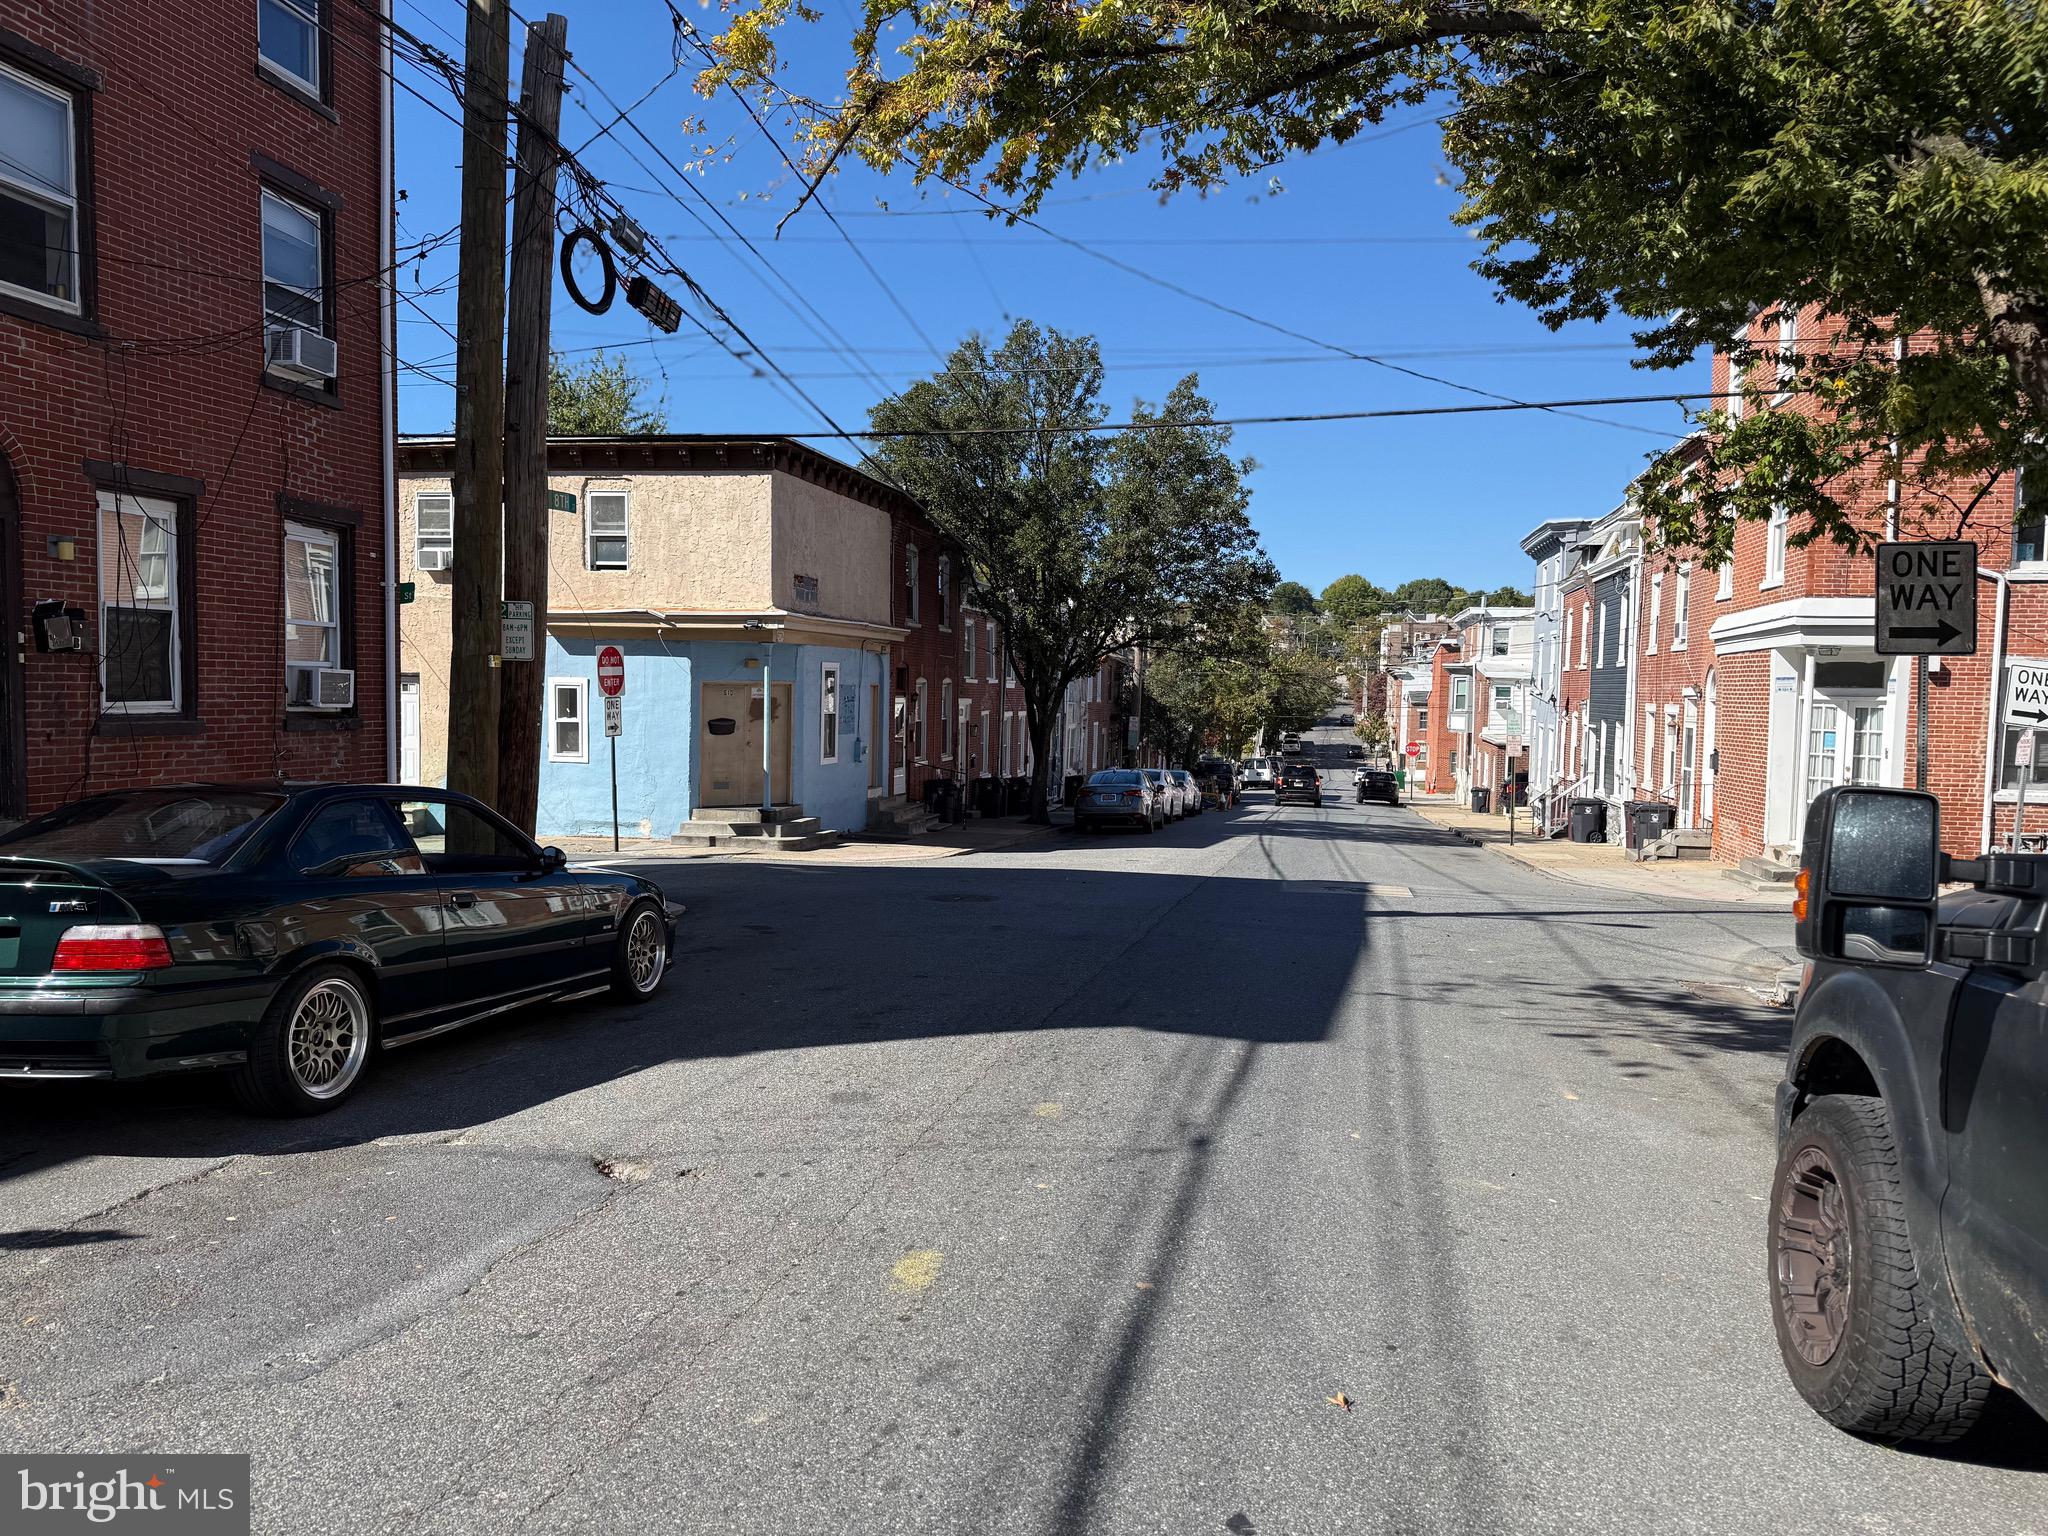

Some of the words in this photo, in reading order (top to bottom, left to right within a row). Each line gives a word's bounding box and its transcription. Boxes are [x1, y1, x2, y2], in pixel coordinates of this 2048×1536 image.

[554, 493, 570, 511] 8TH
[1892, 550, 1961, 577] ONE
[1890, 584, 1963, 610] WAY
[503, 624, 528, 632] 8AM-6PM
[505, 636, 525, 644] EXCEPT
[505, 646, 526, 654] SUNDAY
[601, 656, 609, 665] DO
[610, 656, 621, 665] NOT
[604, 678, 620, 687] ENTER
[606, 700, 620, 710] ONE
[606, 711, 620, 721] WAY
